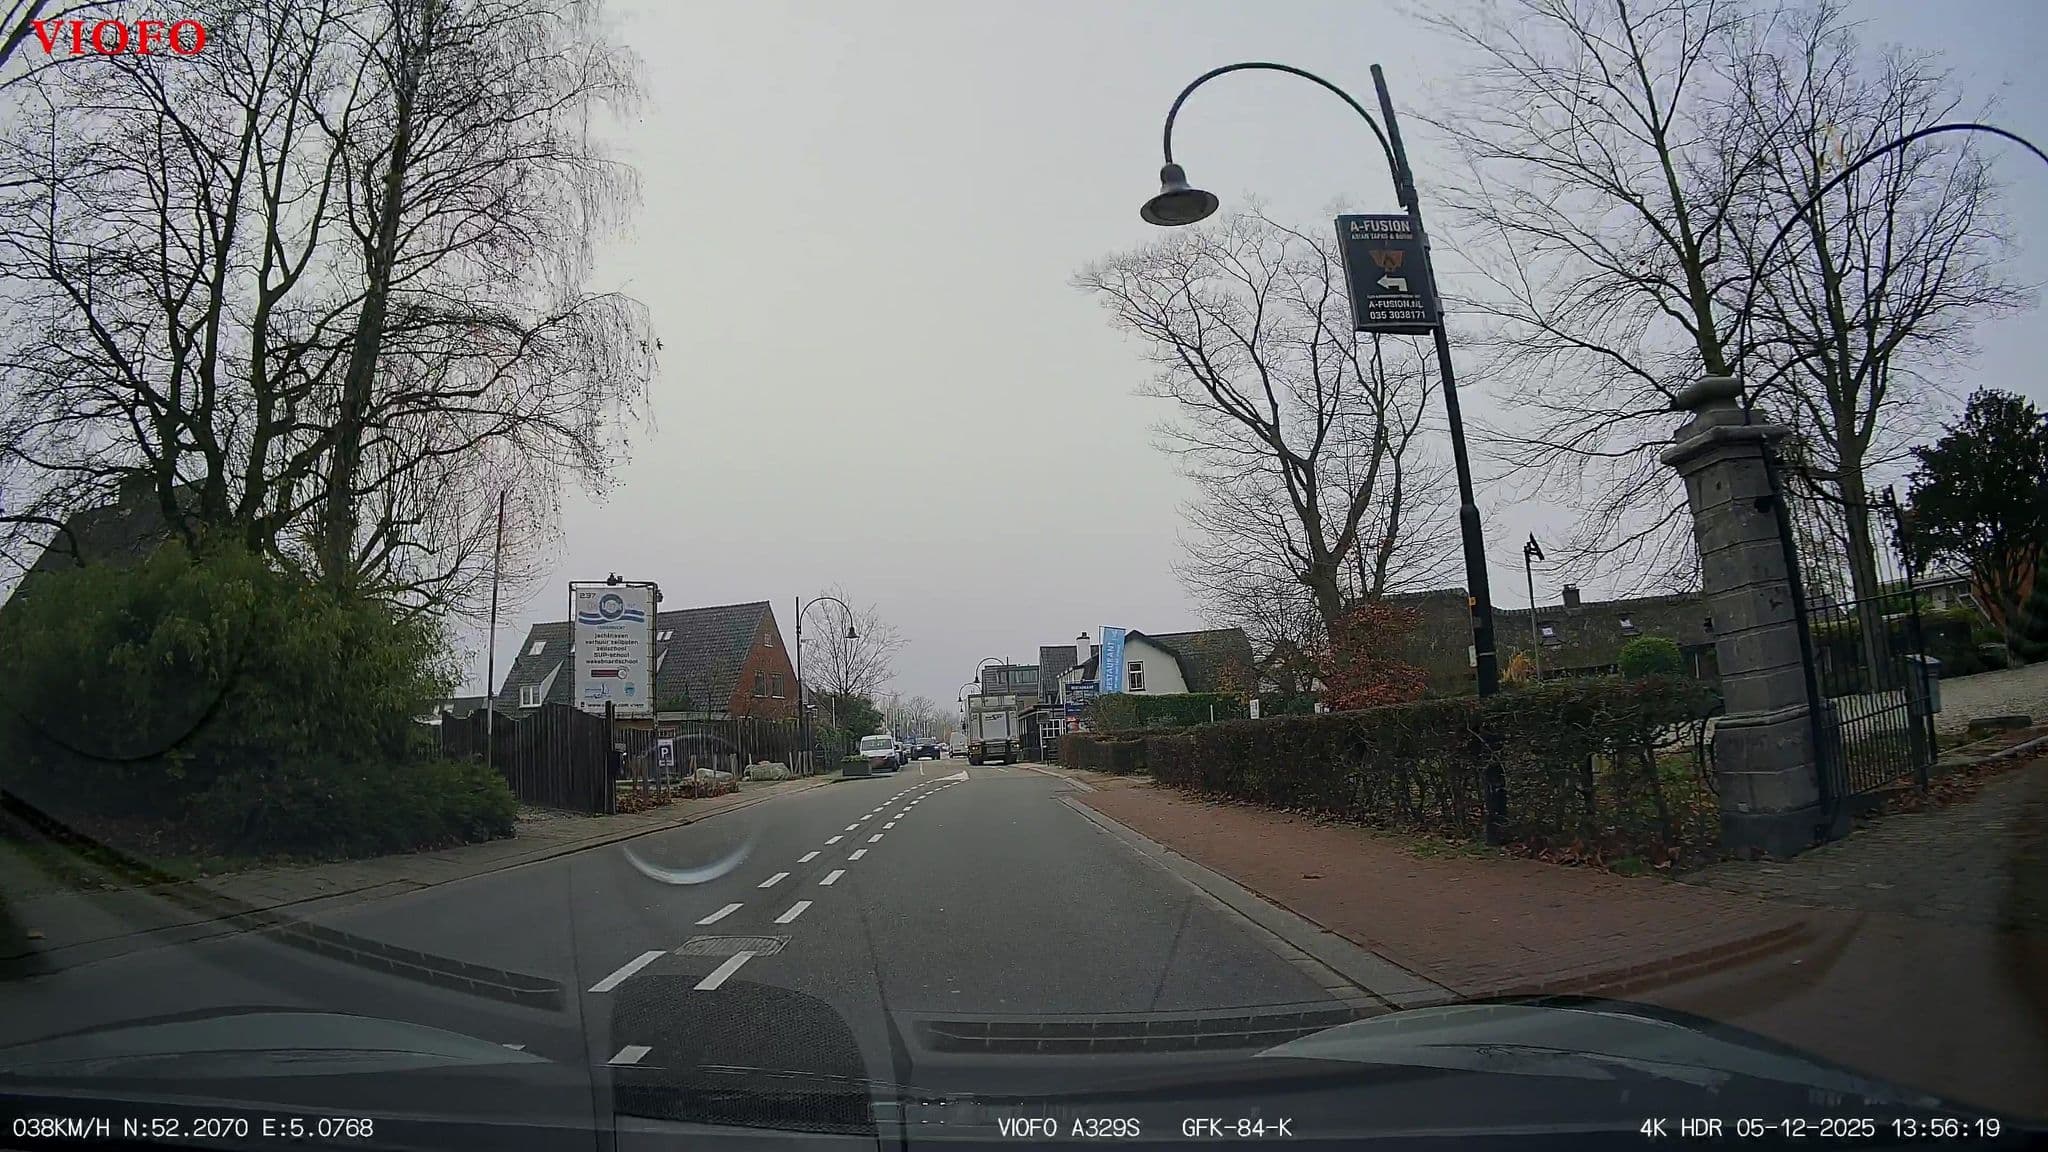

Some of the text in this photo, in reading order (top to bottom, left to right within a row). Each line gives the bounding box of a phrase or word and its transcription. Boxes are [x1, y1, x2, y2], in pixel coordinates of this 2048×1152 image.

[1350, 220, 1410, 232] A-FUSION
[1368, 300, 1424, 308] A-FUSION.NL
[1370, 310, 1426, 319] 035 3038171
[661, 747, 669, 759] P
